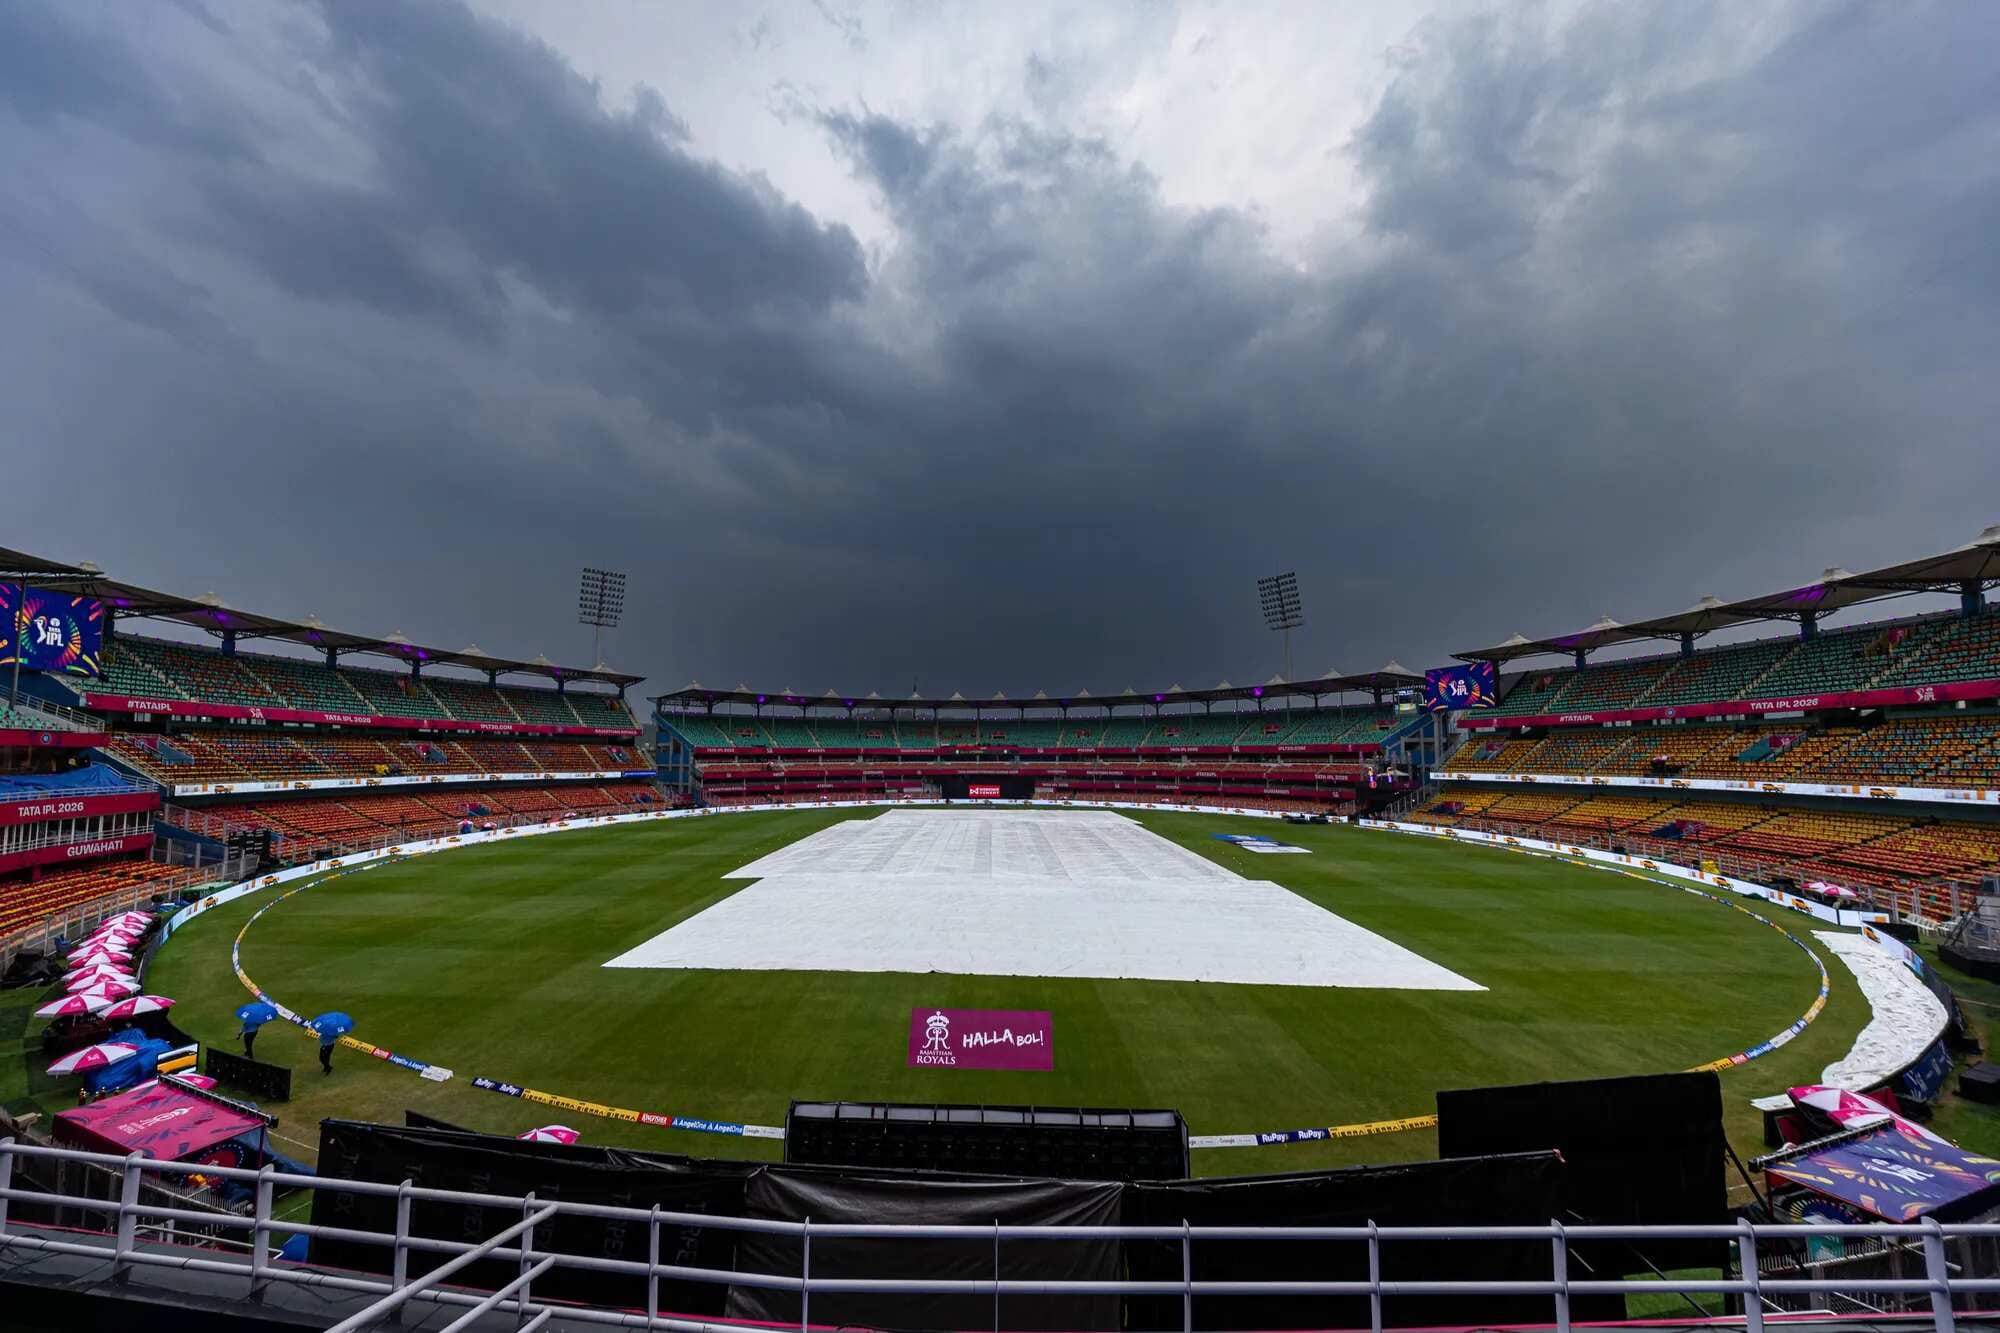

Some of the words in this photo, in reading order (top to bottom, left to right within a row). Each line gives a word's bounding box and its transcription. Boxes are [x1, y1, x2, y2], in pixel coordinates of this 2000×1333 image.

[46, 632, 64, 647] IPL
[127, 701, 173, 712] #TATAIPL
[1750, 702, 1774, 710] TATA
[1776, 701, 1791, 709] IPL
[1793, 699, 1818, 707] 2026
[18, 805, 40, 817] TATA
[43, 804, 56, 815] IPL
[58, 802, 84, 812] 2026
[67, 840, 123, 857] GUWAHATI
[962, 1028, 1015, 1048] HALLA
[1016, 1030, 1044, 1047] BOL!
[916, 1055, 956, 1065] ROYALS
[679, 1119, 707, 1130] AngelOne
[714, 1123, 743, 1134] AngelOne
[1262, 1133, 1285, 1144] RuPay
[1298, 1129, 1322, 1140] RuPay
